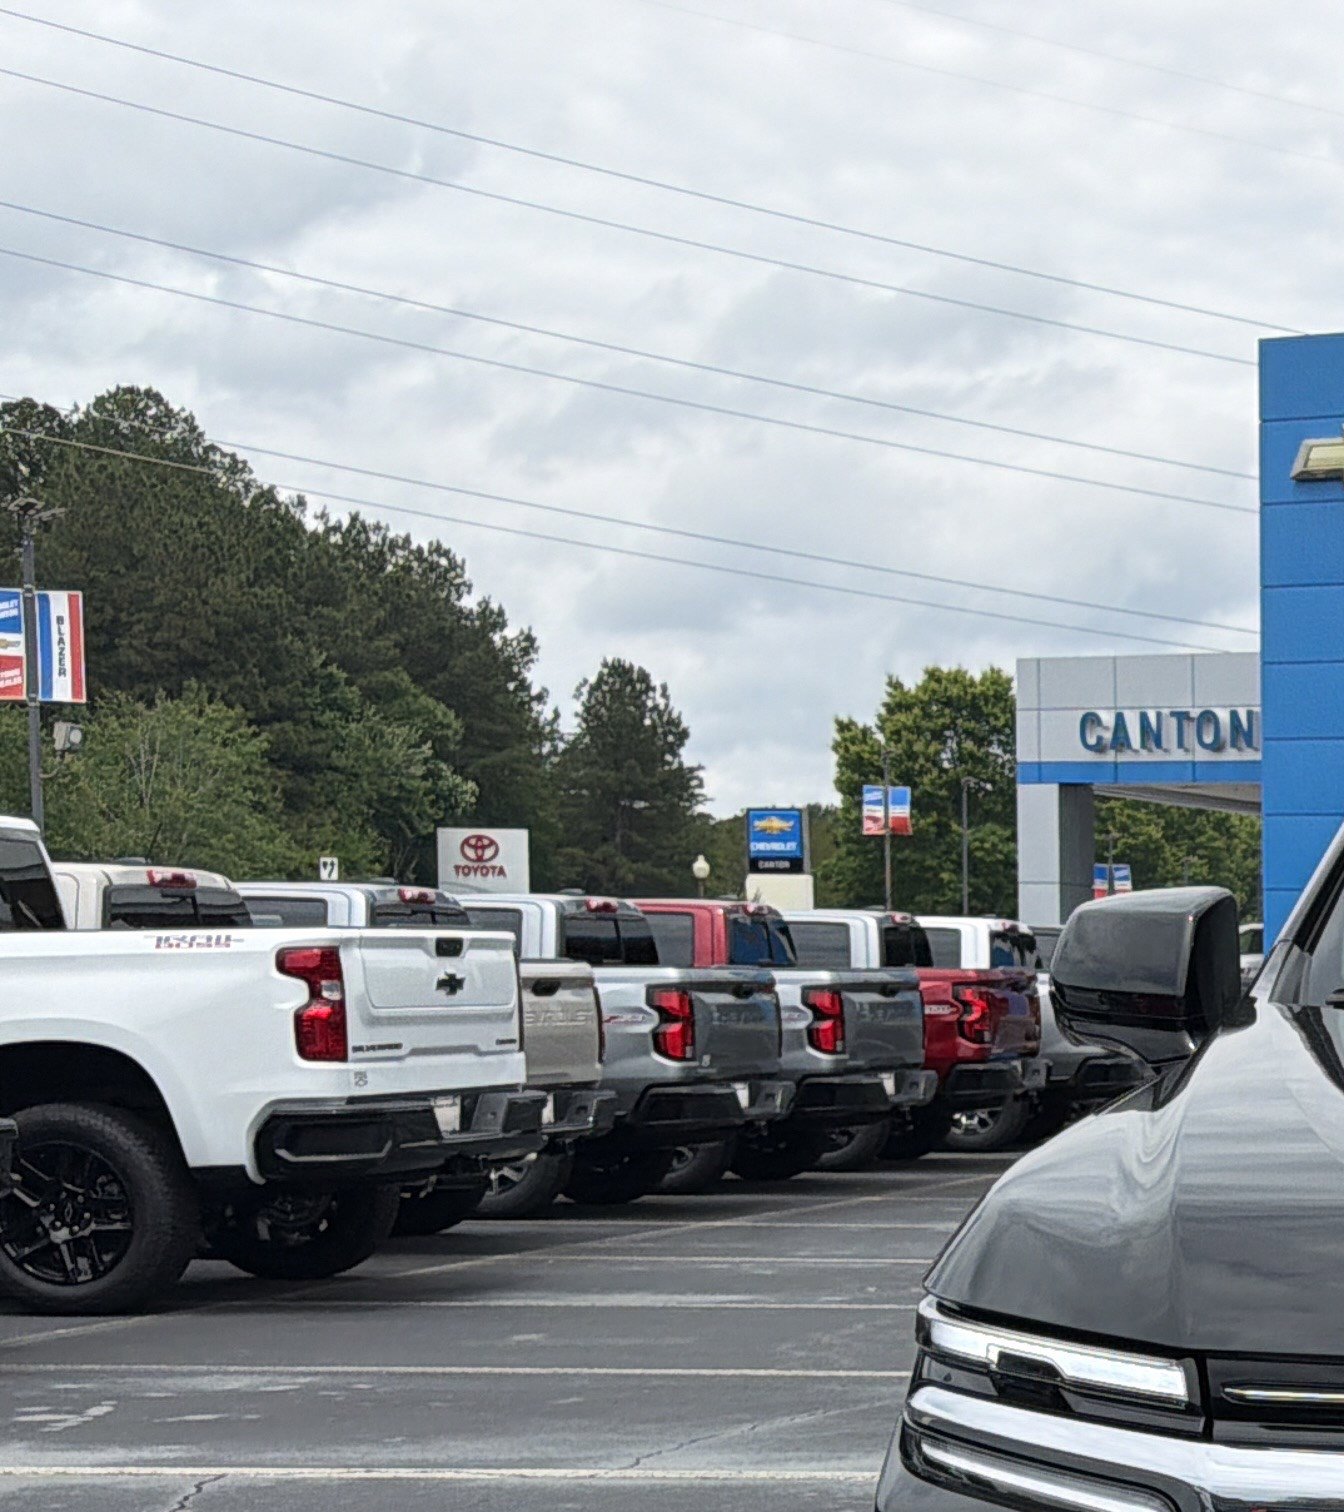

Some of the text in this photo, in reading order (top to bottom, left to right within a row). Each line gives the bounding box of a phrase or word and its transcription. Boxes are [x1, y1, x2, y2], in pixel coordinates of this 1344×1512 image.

[56, 615, 66, 677] BLAZER
[1079, 709, 1256, 753] CANTON
[453, 865, 507, 878] TOYOTA
